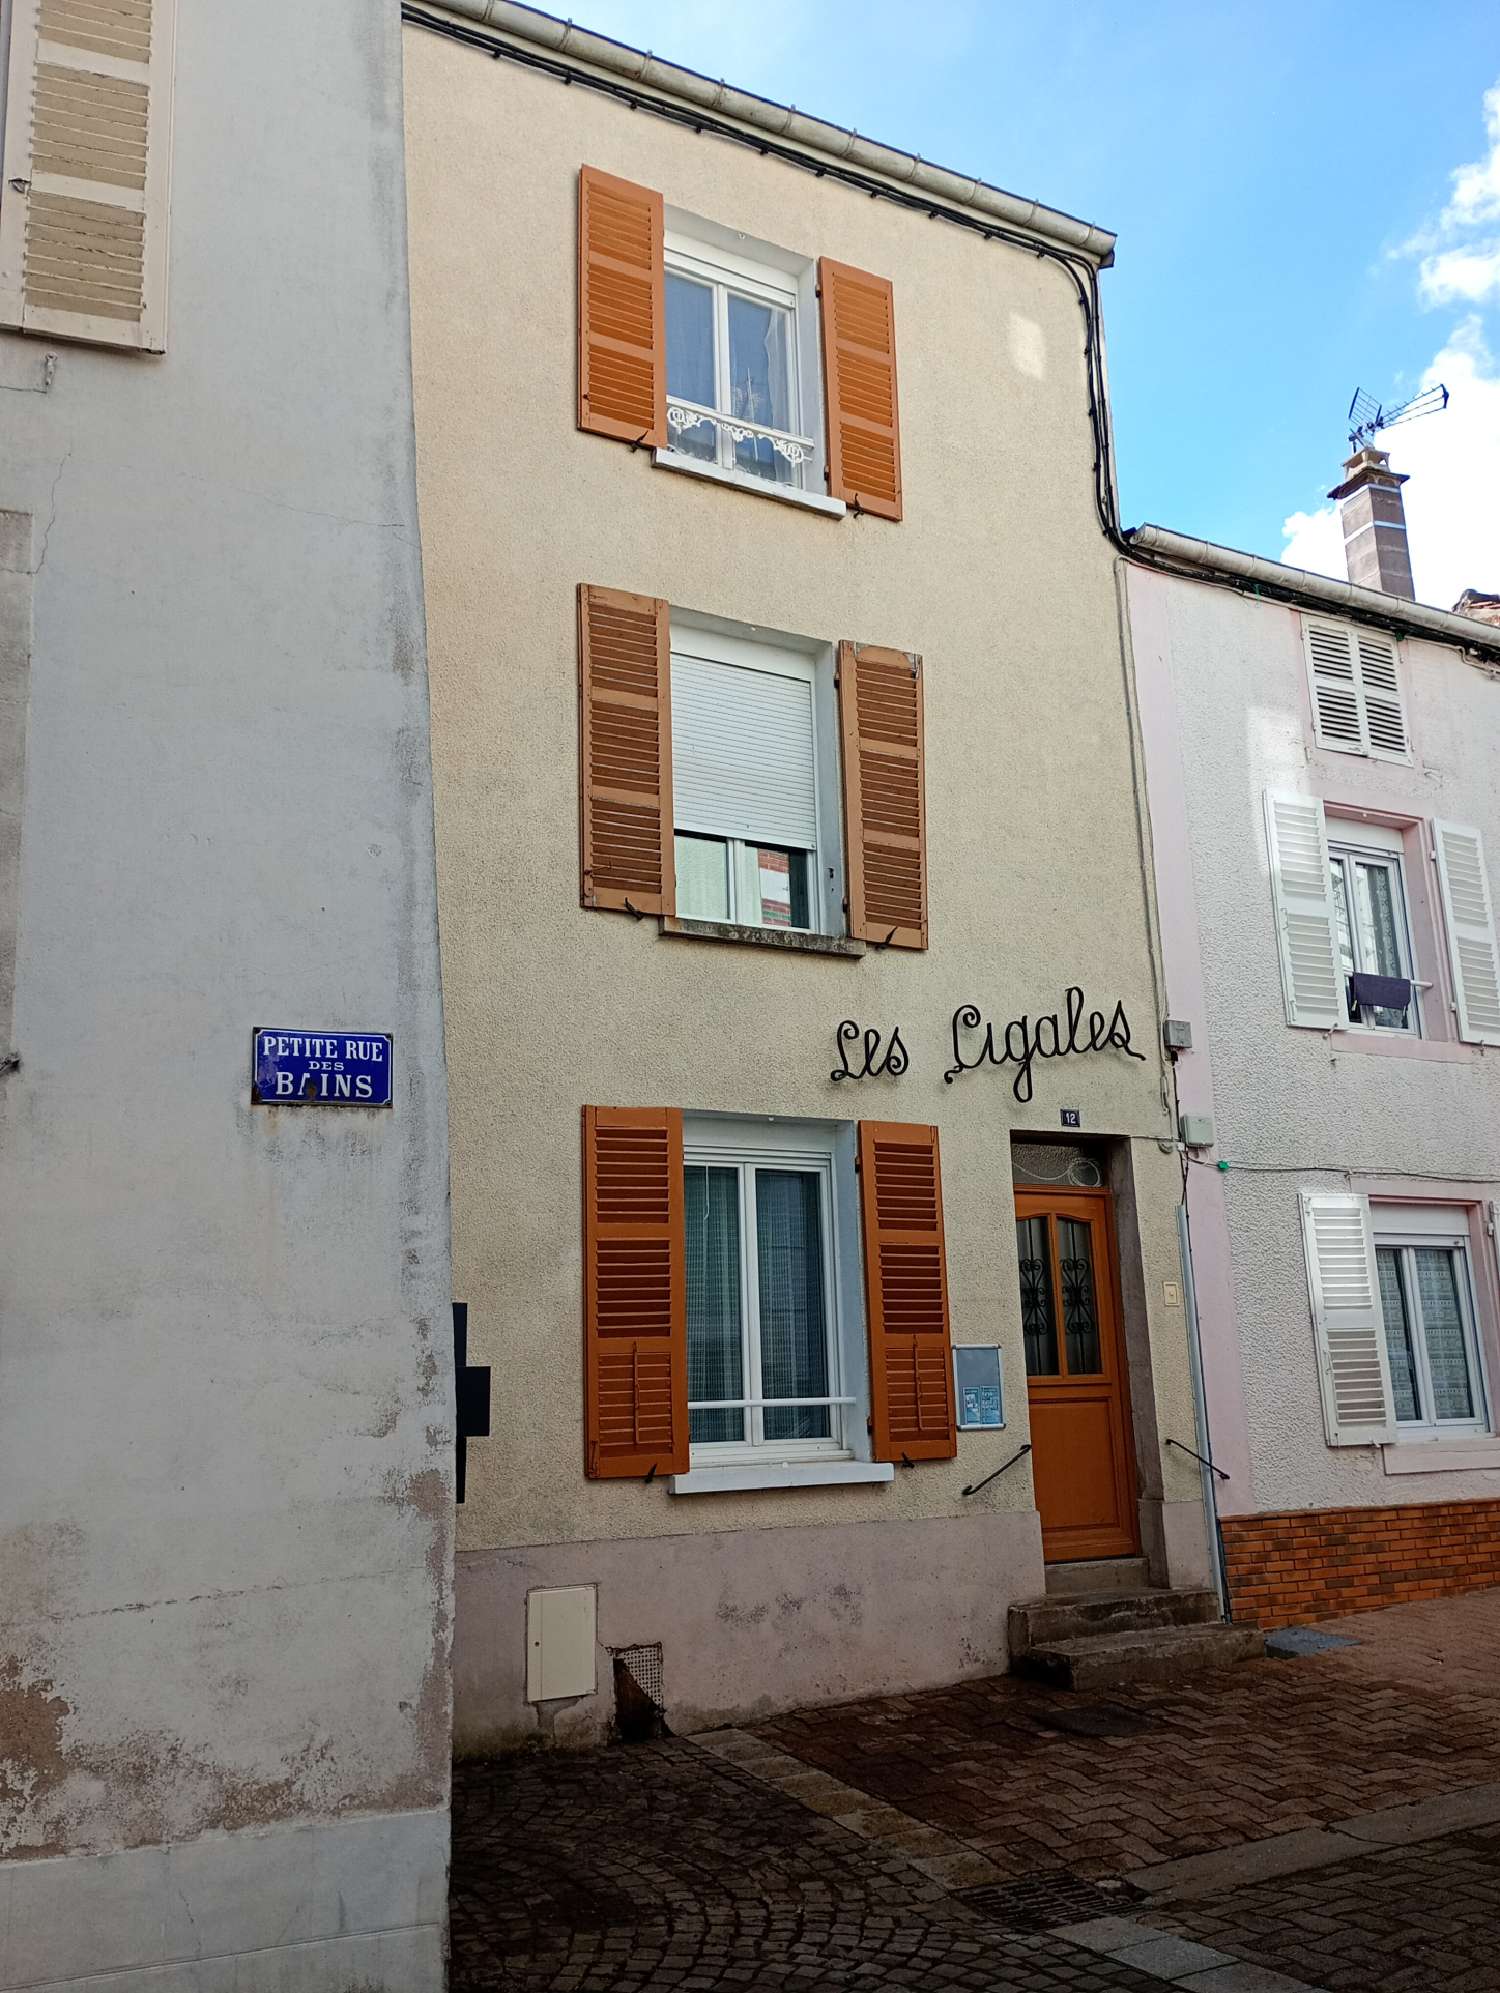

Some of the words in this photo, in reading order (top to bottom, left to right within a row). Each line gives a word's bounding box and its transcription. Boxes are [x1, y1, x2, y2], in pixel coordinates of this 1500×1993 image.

[263, 1035, 338, 1059] PETITE
[345, 1040, 383, 1062] RUE
[830, 1020, 909, 1082] Les
[943, 986, 1146, 1103] Cigales
[308, 1061, 345, 1071] DES
[1066, 1112, 1076, 1124] 12
